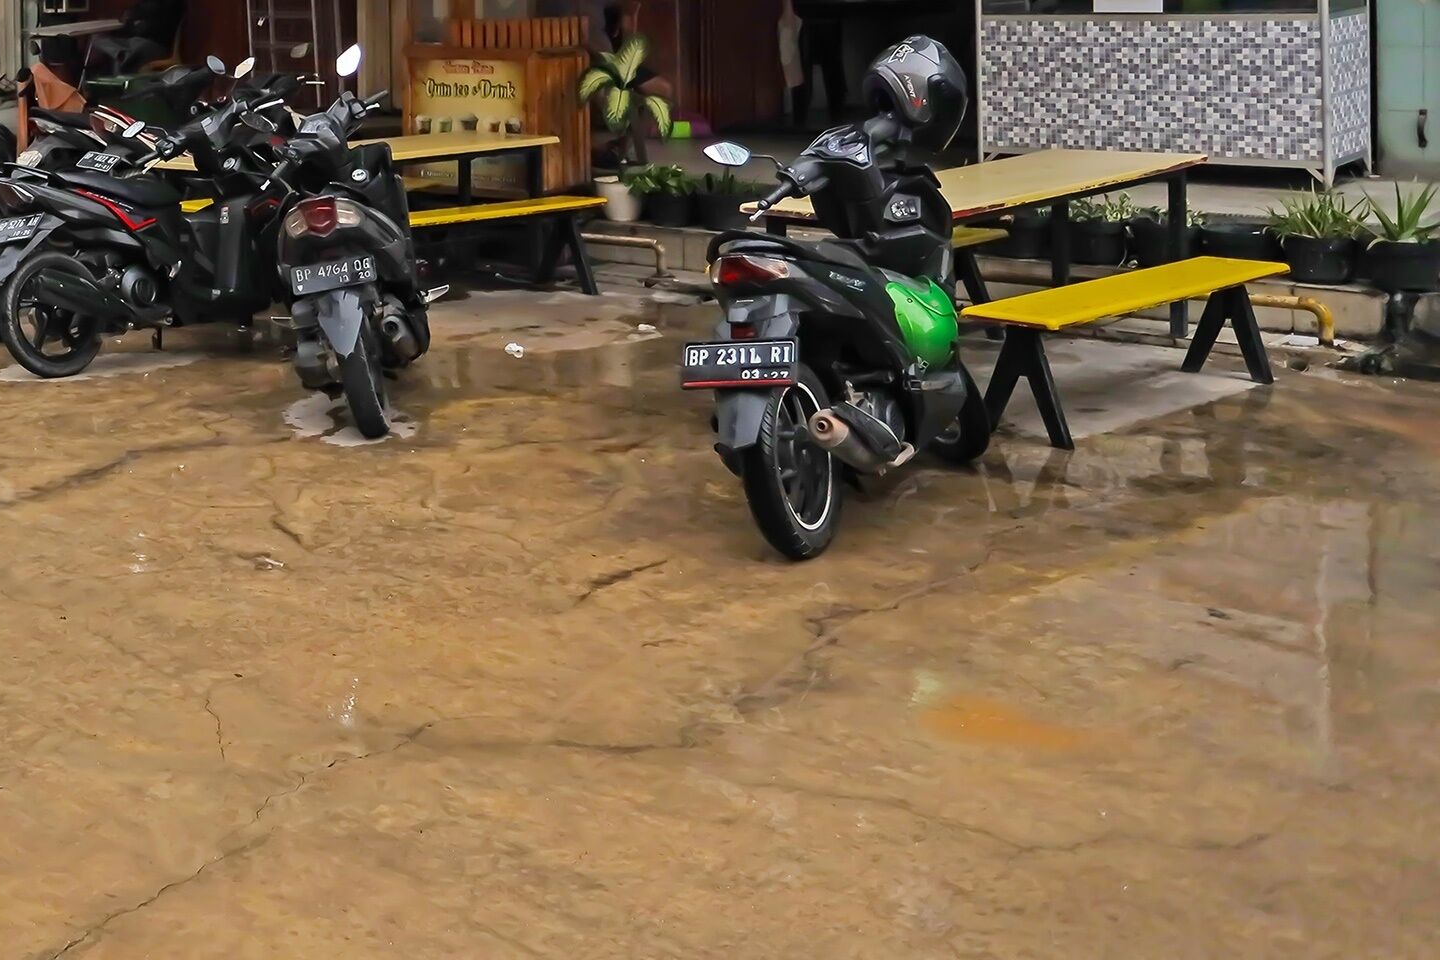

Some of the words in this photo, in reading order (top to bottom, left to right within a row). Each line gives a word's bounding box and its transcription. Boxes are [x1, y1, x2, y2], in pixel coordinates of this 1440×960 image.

[478, 79, 516, 98] Drink
[295, 269, 311, 283] BP
[689, 348, 709, 367] BP
[770, 346, 790, 363] RI
